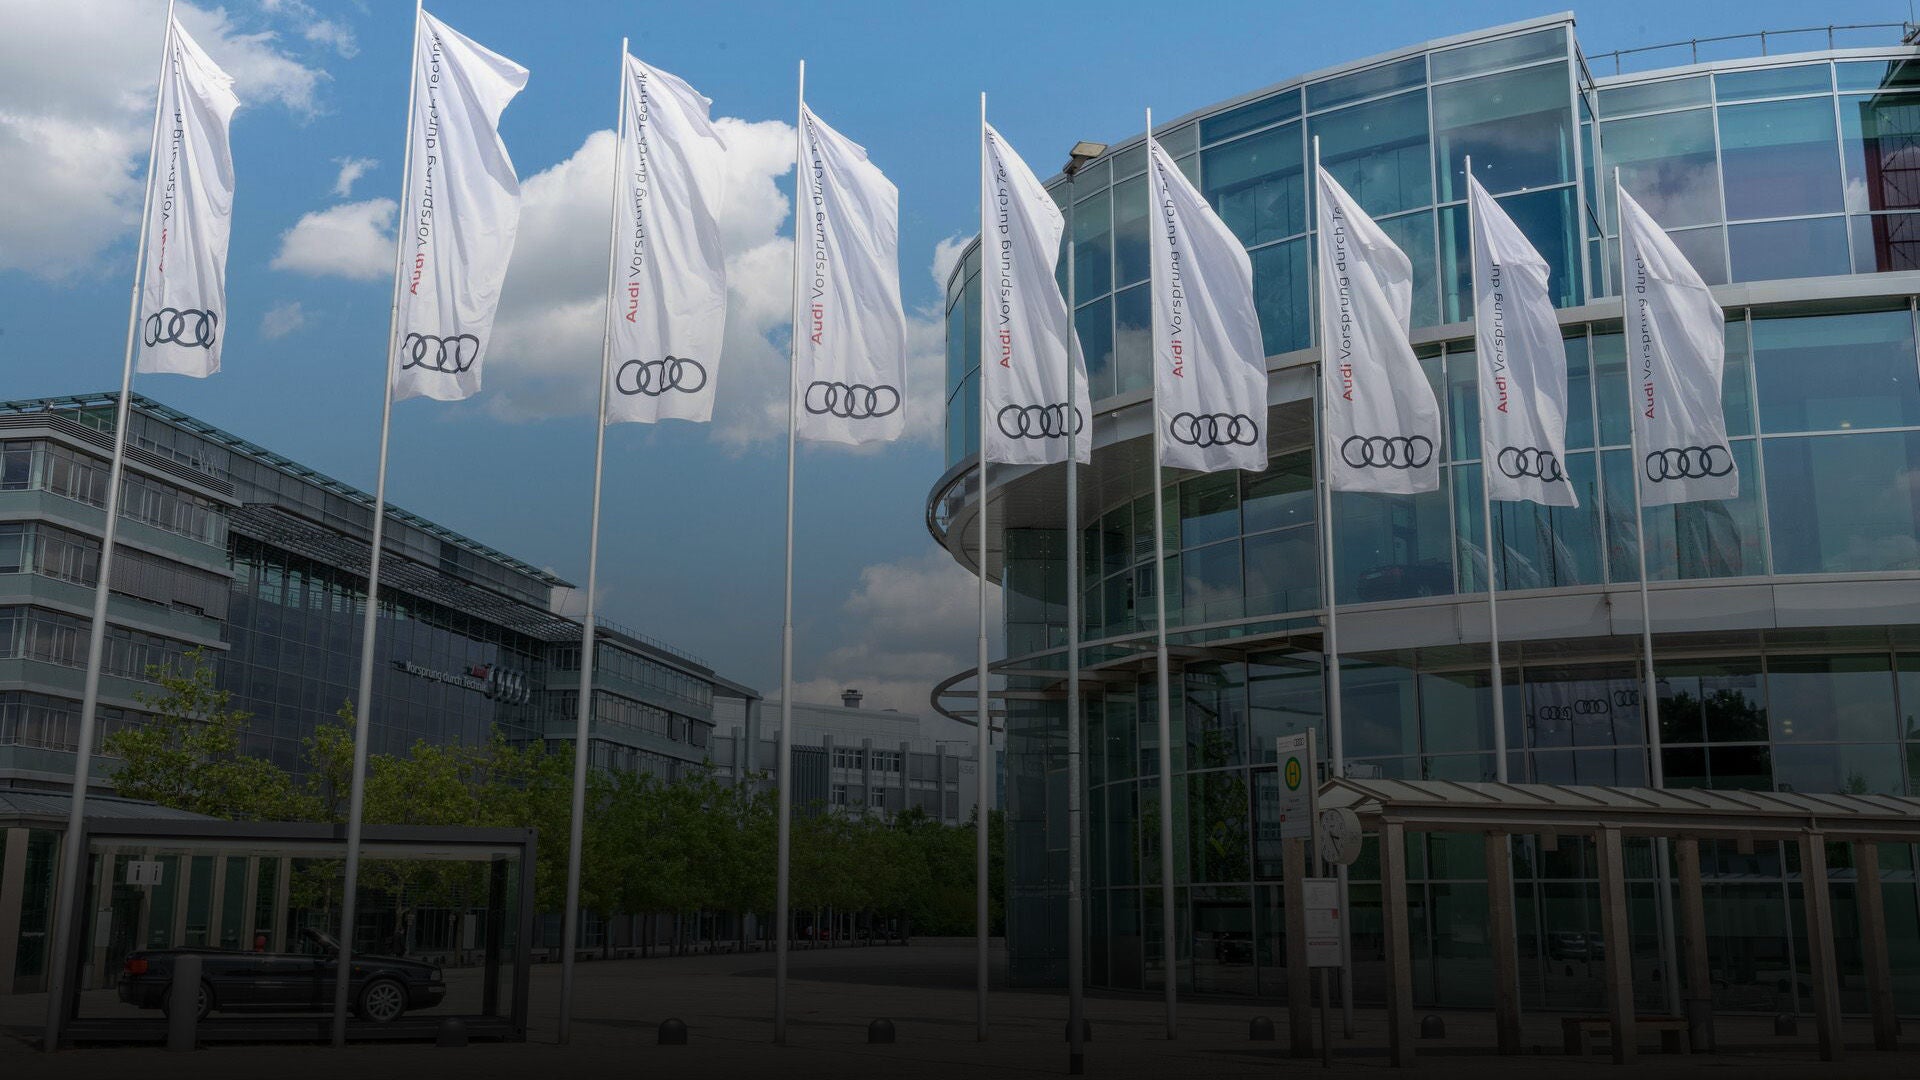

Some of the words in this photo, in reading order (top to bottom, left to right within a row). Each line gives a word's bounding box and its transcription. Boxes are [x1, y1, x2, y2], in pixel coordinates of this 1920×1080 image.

[635, 136, 648, 183] durch
[812, 160, 823, 206] durch
[629, 188, 648, 278] Vorsprung
[998, 190, 1009, 235] durch
[1164, 199, 1177, 246] durch
[812, 212, 828, 299] Vorsprung
[1333, 227, 1347, 272] durch
[410, 252, 425, 296] Audi
[1000, 240, 1013, 326] Vorsprung
[1170, 251, 1184, 336] Vorsprung
[1490, 260, 1502, 288] dur
[626, 282, 640, 323] Audi
[811, 304, 824, 345] Audi
[1339, 277, 1353, 360] Vorsprung
[999, 329, 1011, 368] Audi
[1493, 293, 1507, 373] Vorsprung
[1171, 340, 1184, 378] Audi
[1340, 363, 1353, 401] Audi
[1495, 377, 1508, 413] Audi
[1643, 382, 1655, 419] Audi
[405, 660, 442, 683] Vorsprung
